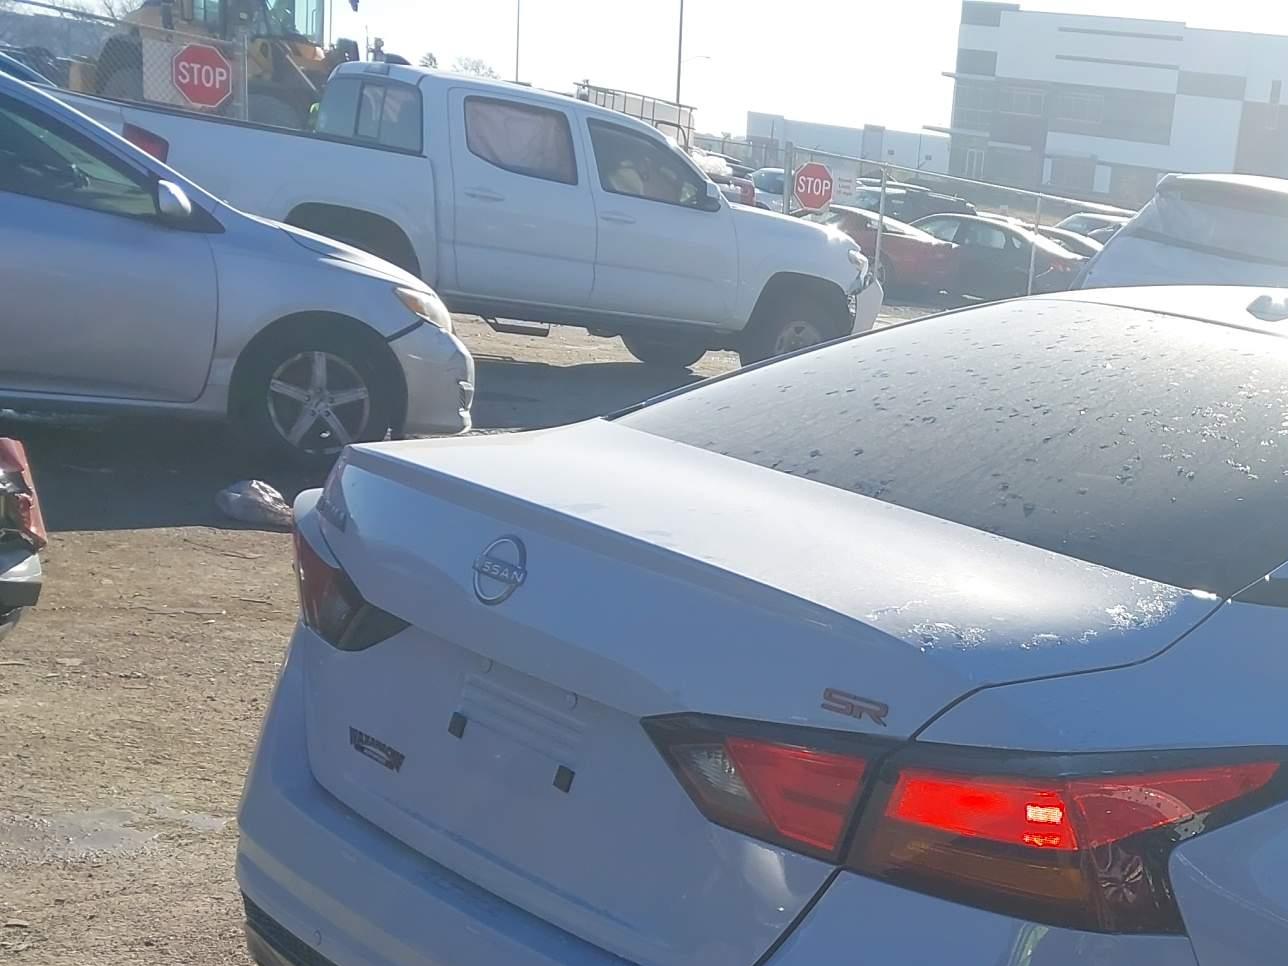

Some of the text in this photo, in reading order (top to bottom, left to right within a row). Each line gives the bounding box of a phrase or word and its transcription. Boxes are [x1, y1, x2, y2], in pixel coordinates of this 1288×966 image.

[178, 61, 227, 89] STOP
[797, 175, 831, 197] STOP
[821, 687, 889, 728] SR
